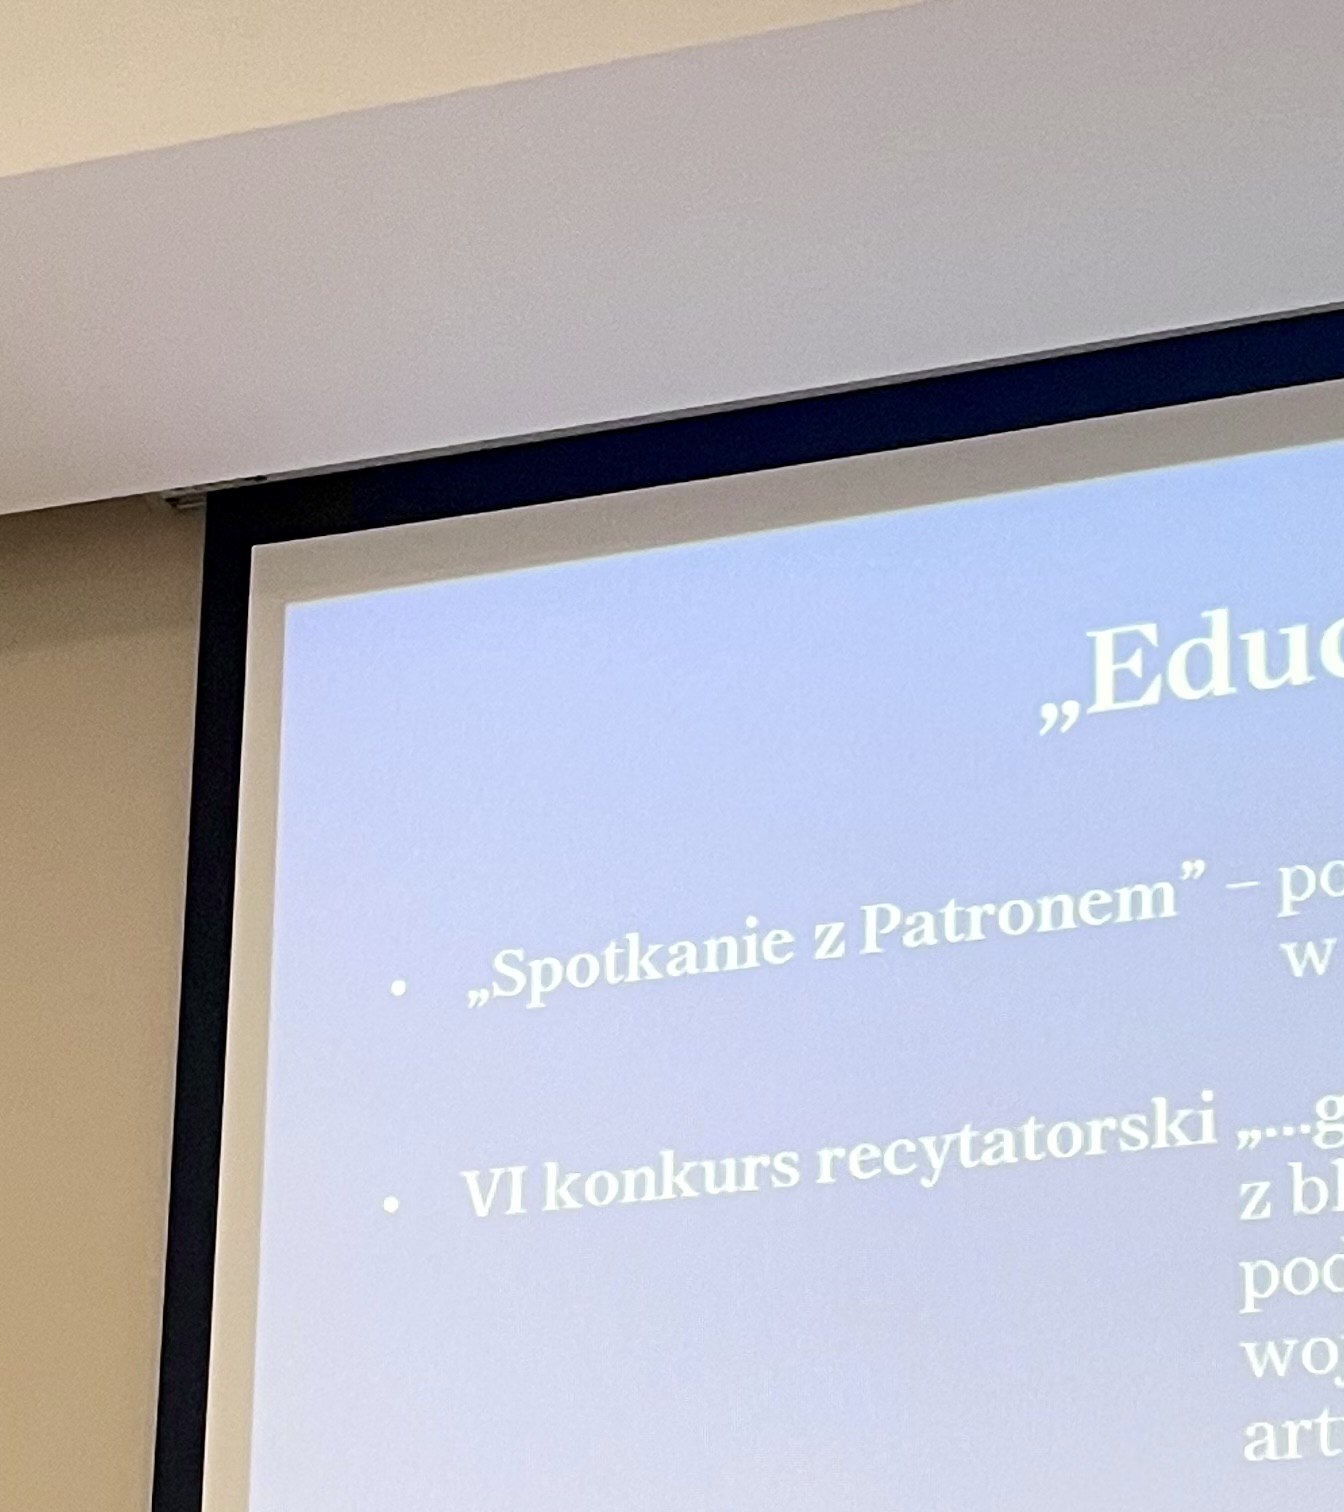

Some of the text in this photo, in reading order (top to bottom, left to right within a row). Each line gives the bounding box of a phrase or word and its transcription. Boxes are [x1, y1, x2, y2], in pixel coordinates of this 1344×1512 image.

[467, 915, 795, 1009] „Spotkanie
[814, 922, 846, 960] z
[860, 859, 1206, 954] Patronem”
[1280, 938, 1337, 978] w
[460, 1165, 528, 1218] VI
[542, 1149, 801, 1211] konkurs
[816, 1089, 1218, 1188] recytatorski
[1240, 1181, 1272, 1220] z
